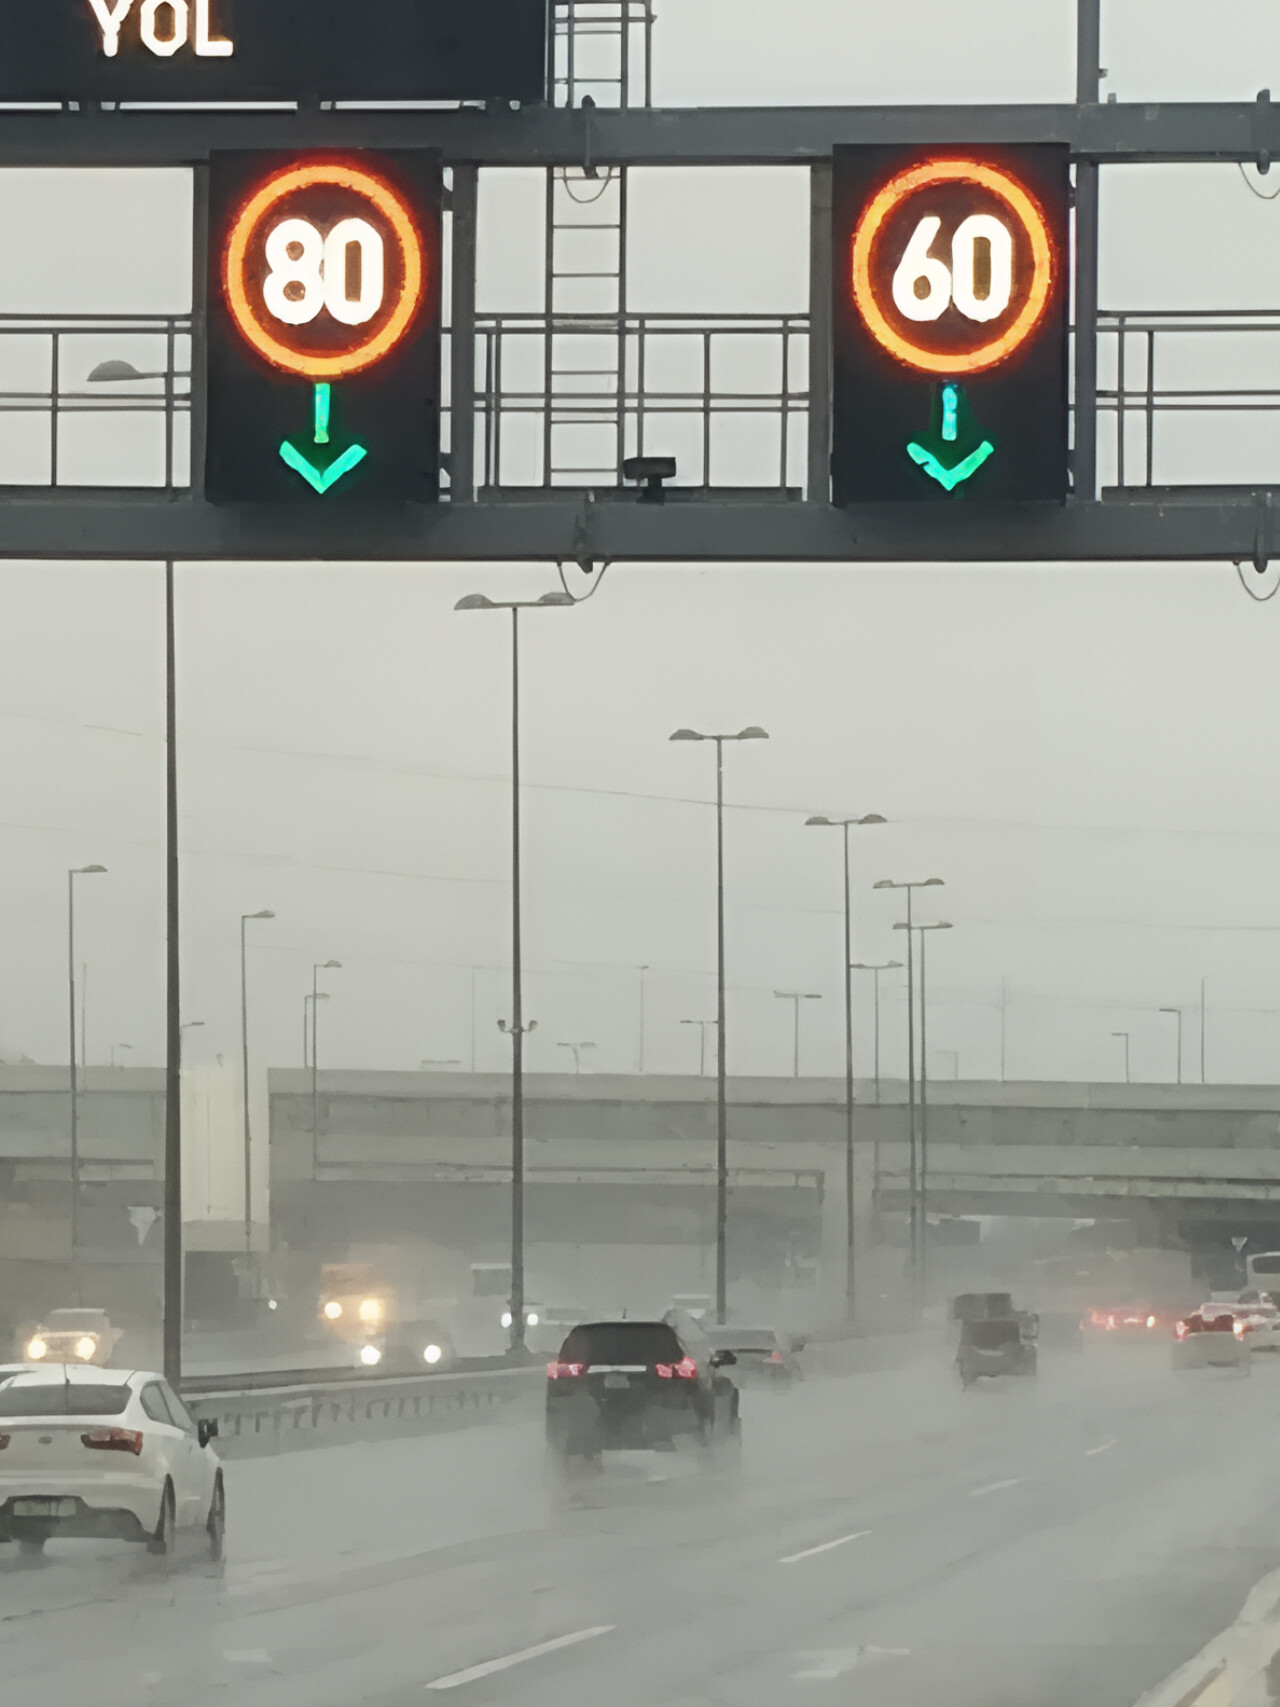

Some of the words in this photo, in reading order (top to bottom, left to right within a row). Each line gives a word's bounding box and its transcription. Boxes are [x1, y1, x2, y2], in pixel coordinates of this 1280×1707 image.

[88, 0, 234, 57] YOL
[261, 217, 385, 327] 80
[891, 212, 1013, 323] 60
